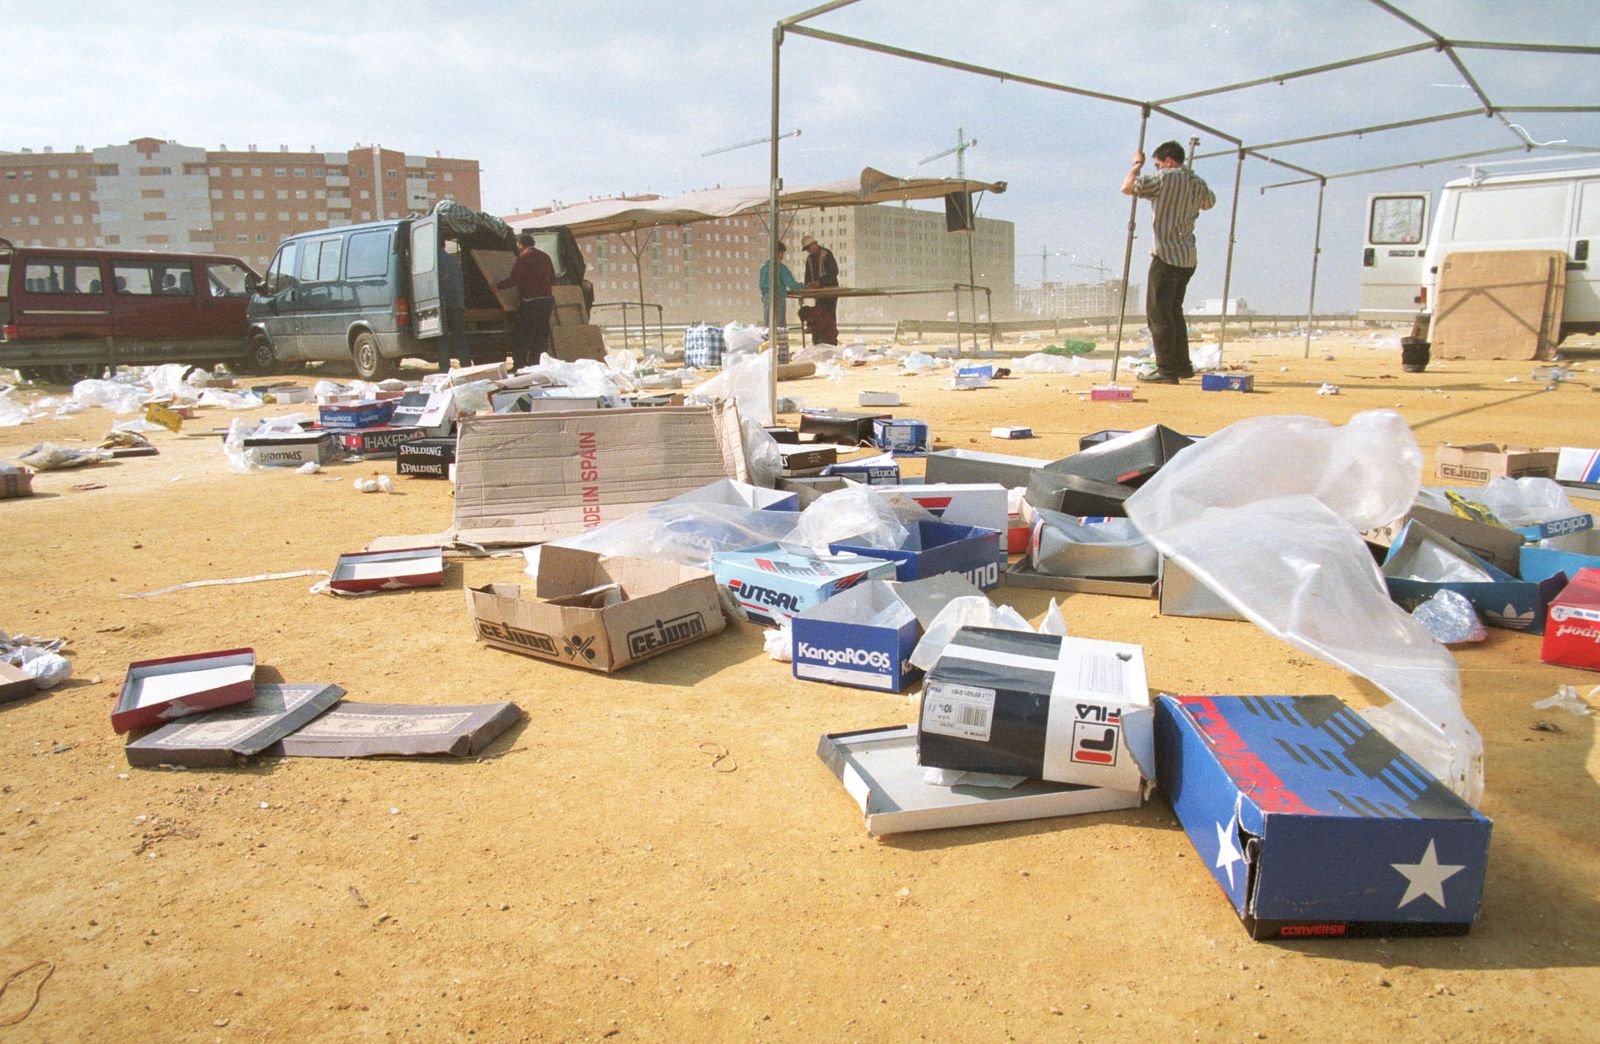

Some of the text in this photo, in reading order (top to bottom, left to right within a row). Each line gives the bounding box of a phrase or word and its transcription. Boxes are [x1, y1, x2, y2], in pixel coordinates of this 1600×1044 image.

[400, 444, 441, 455] SPALDING
[400, 463, 441, 473] SPALDING
[579, 432, 601, 528] ADE IN SPAIN
[1546, 516, 1588, 534] adidas
[728, 579, 800, 612] FUTSAL
[798, 641, 891, 669] KangaROOS
[1076, 703, 1121, 723] FILA
[1280, 924, 1346, 937] CONVERSE
